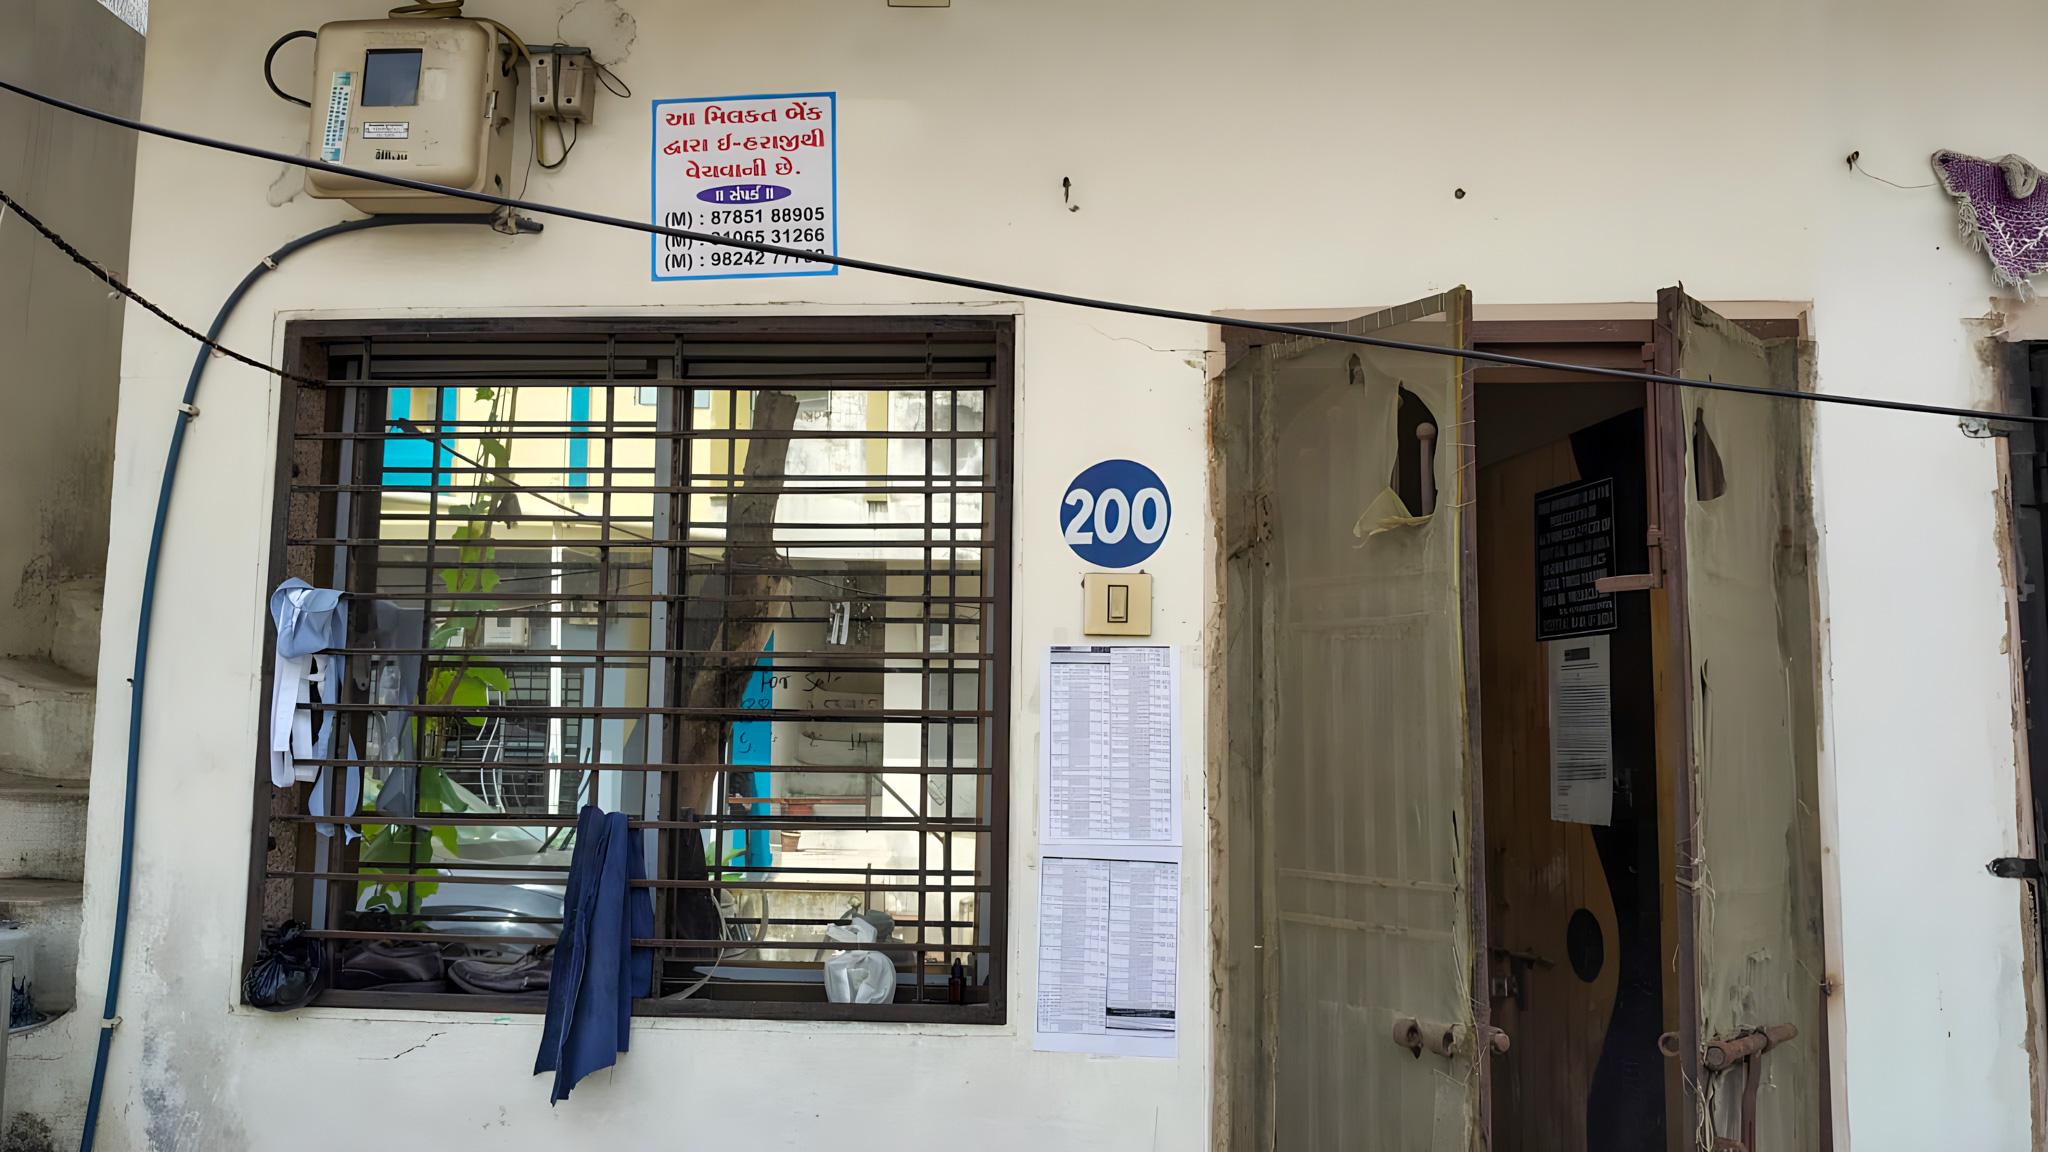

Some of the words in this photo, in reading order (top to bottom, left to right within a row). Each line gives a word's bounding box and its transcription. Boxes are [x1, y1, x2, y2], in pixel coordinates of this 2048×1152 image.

[665, 112, 695, 126] આ
[704, 105, 777, 125] મિલકત
[785, 102, 823, 121] બેંક
[663, 138, 708, 155] દ્વારા
[686, 158, 767, 179] વેચવાની
[665, 211, 693, 230] (M)
[711, 209, 763, 225] 87851
[771, 207, 825, 223] 88905
[771, 228, 825, 244] 31266
[665, 254, 693, 272] (M)
[711, 251, 765, 266] 98242
[1064, 487, 1168, 545] 200
